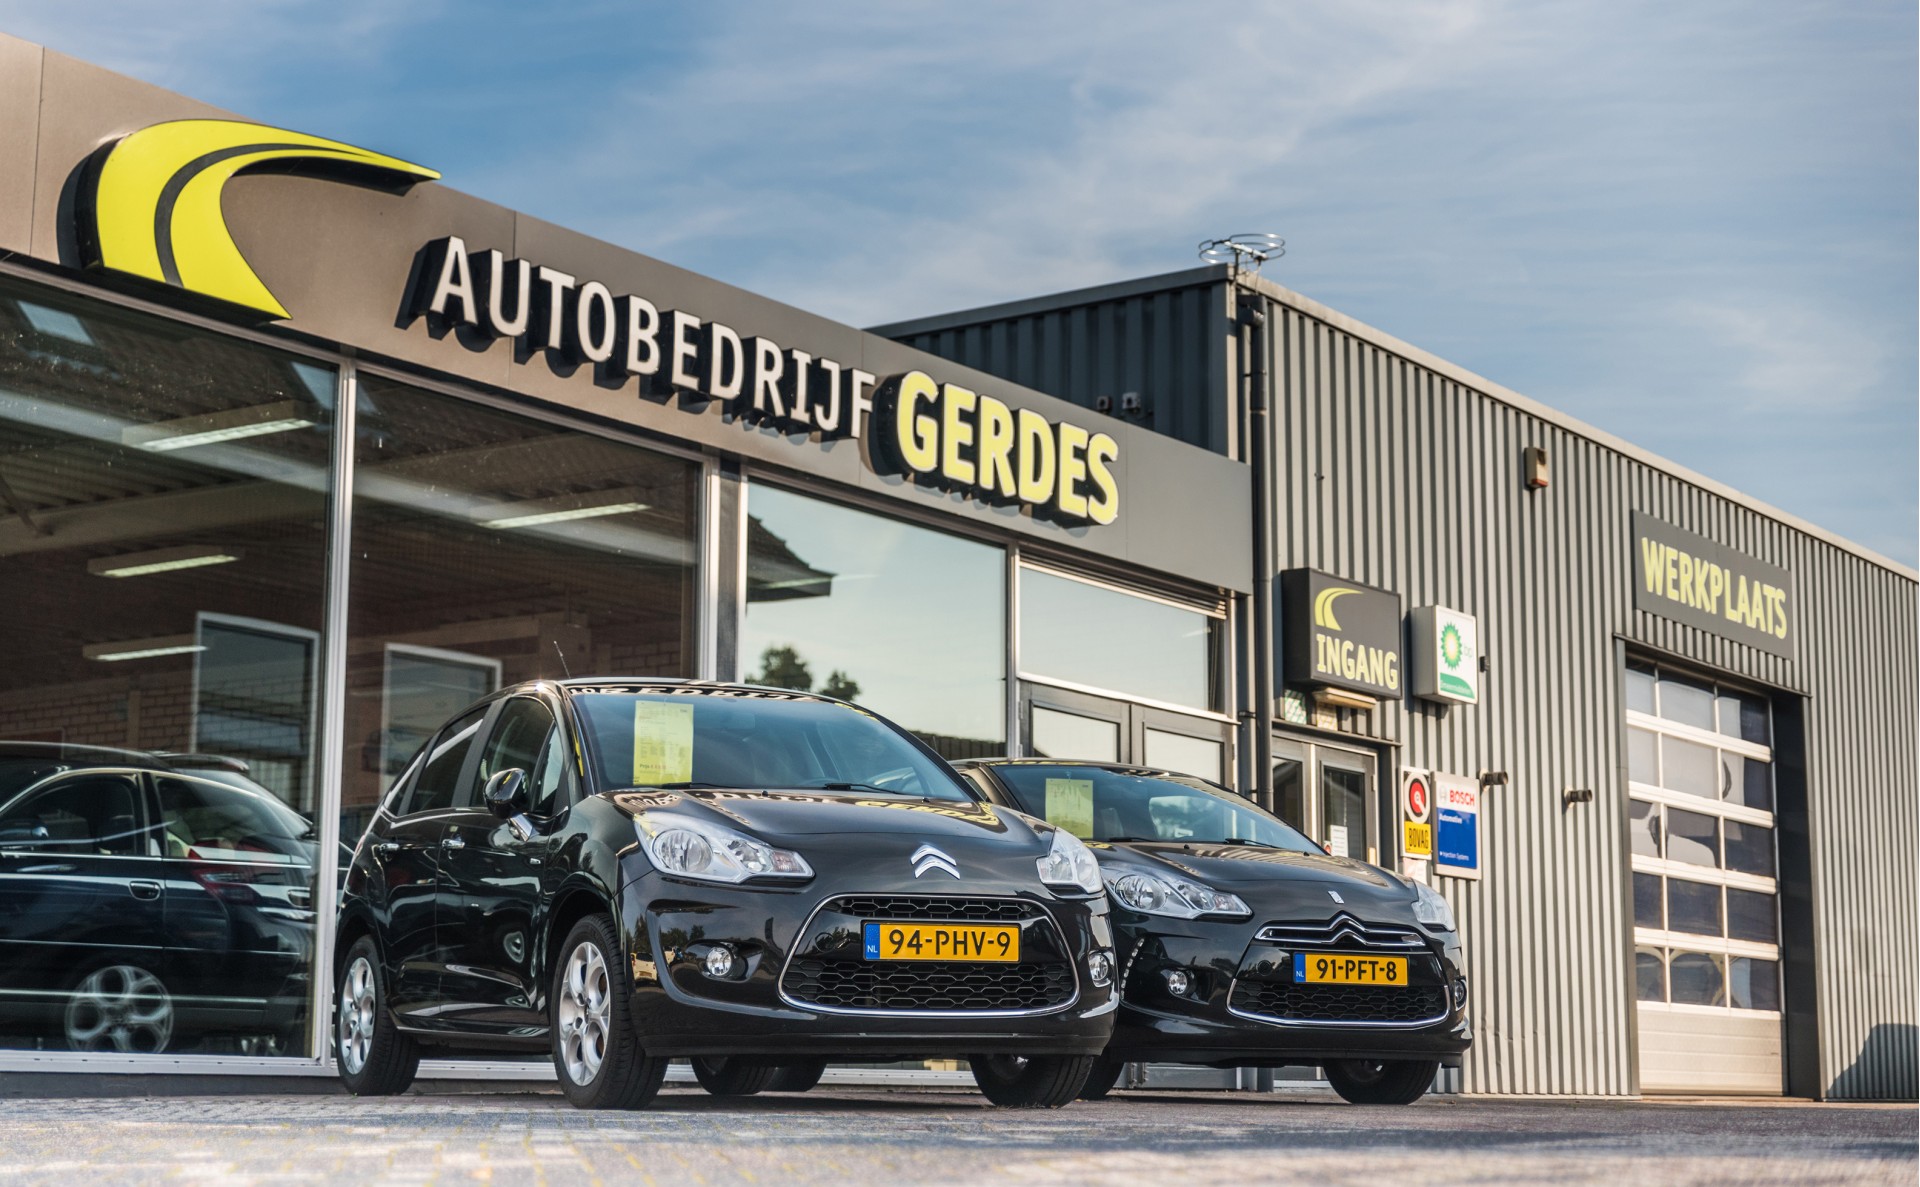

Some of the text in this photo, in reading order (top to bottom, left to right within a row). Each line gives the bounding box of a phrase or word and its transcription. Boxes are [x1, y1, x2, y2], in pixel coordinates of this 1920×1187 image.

[430, 235, 1120, 527] AUTOBEDRIJF GERDES
[1641, 537, 1788, 640] WERKPLAATS
[1316, 633, 1399, 690] INGANG
[1449, 789, 1475, 806] BOSCH
[1408, 828, 1430, 850] BOVAG
[867, 945, 879, 953] NL
[889, 929, 1011, 957] 94-PHV-9
[1296, 970, 1305, 978] NL
[1316, 958, 1397, 982] 91-PFT-8
